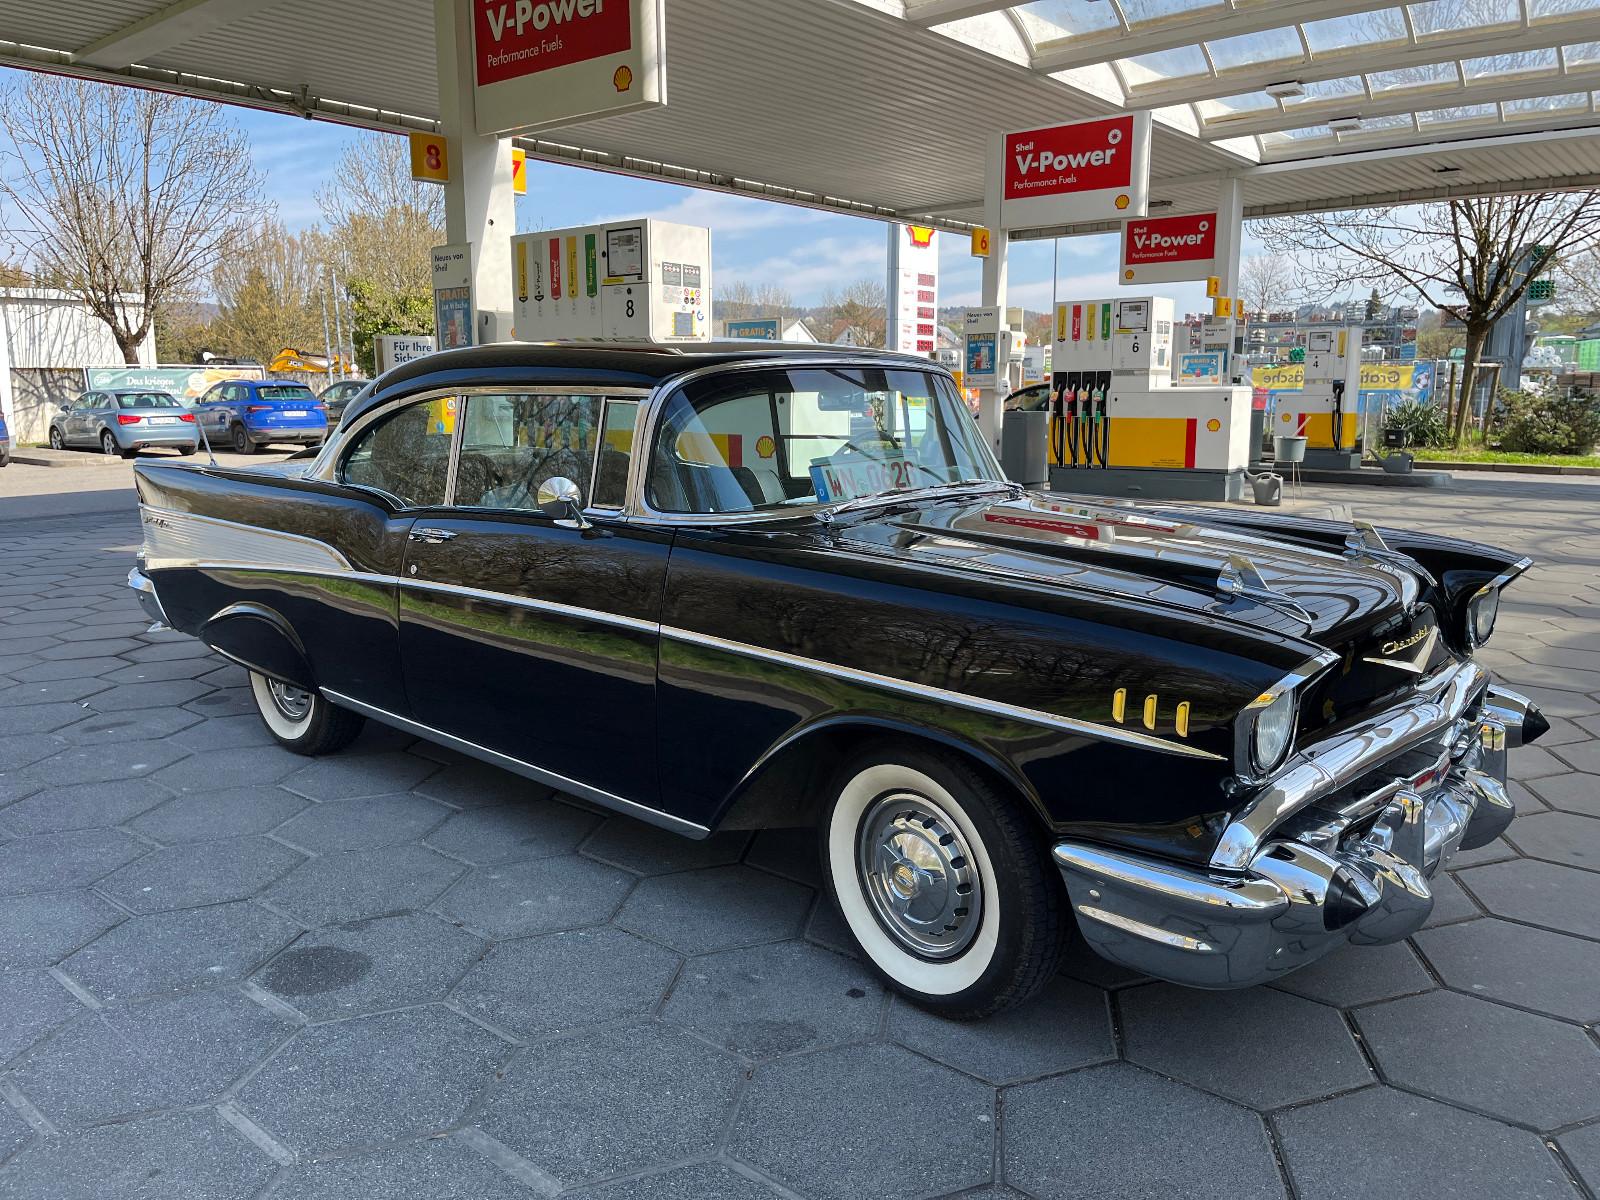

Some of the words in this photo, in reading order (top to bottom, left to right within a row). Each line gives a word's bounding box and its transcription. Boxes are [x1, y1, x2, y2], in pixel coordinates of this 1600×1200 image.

[487, 46, 540, 68] Performance
[541, 33, 563, 54] Fuels
[1015, 141, 1034, 152] Shell
[426, 143, 442, 171] 8
[1015, 147, 1116, 175] V-Power
[1013, 178, 1057, 190] Performance
[1058, 173, 1077, 185] Fuels
[980, 234, 988, 250] 6
[1133, 233, 1205, 250] V-Power
[434, 263, 448, 272] Shell
[440, 288, 470, 300] GRATIS
[625, 299, 635, 318] 8
[740, 328, 765, 337] GRATIS
[393, 342, 409, 351] Für
[412, 342, 432, 351] Ihre
[1132, 342, 1140, 353] 6
[1312, 360, 1319, 368] 4
[126, 376, 144, 386] Das
[144, 376, 175, 387] kriegen
